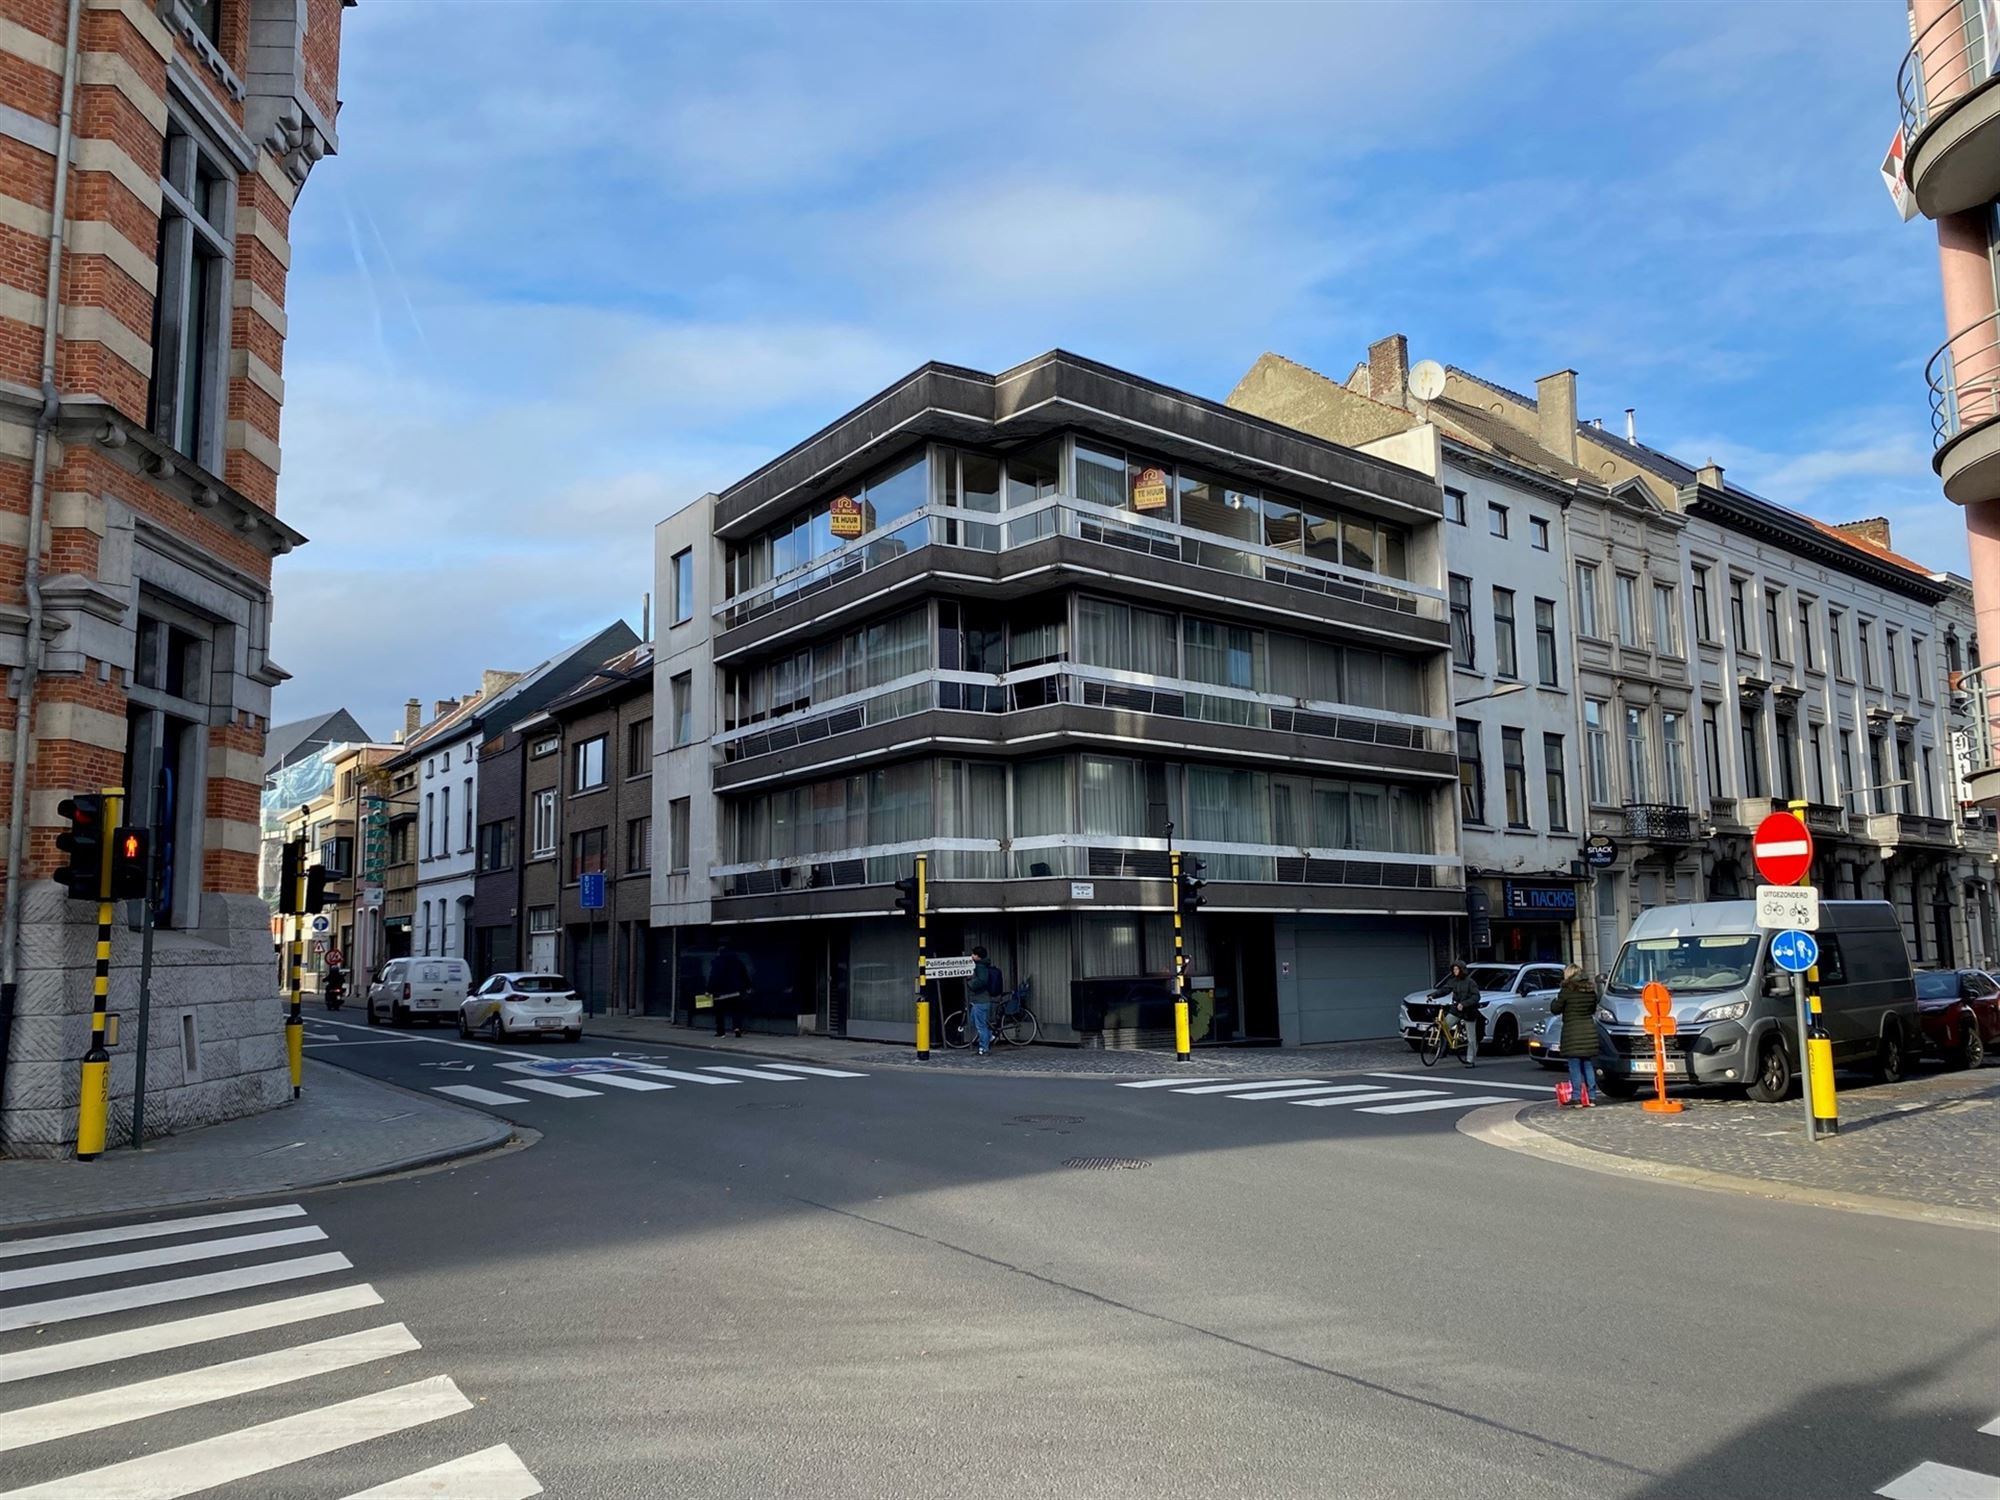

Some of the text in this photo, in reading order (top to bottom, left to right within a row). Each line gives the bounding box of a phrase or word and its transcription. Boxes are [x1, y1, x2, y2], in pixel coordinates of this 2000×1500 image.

[1137, 487, 1164, 498] TE HUUR
[841, 516, 858, 524] HUUR
[1513, 890, 1575, 907] EL NACHOS
[1763, 891, 1809, 899] UITGEZONDERD
[926, 959, 973, 967] Politiediensten
[937, 968, 972, 977] Station
